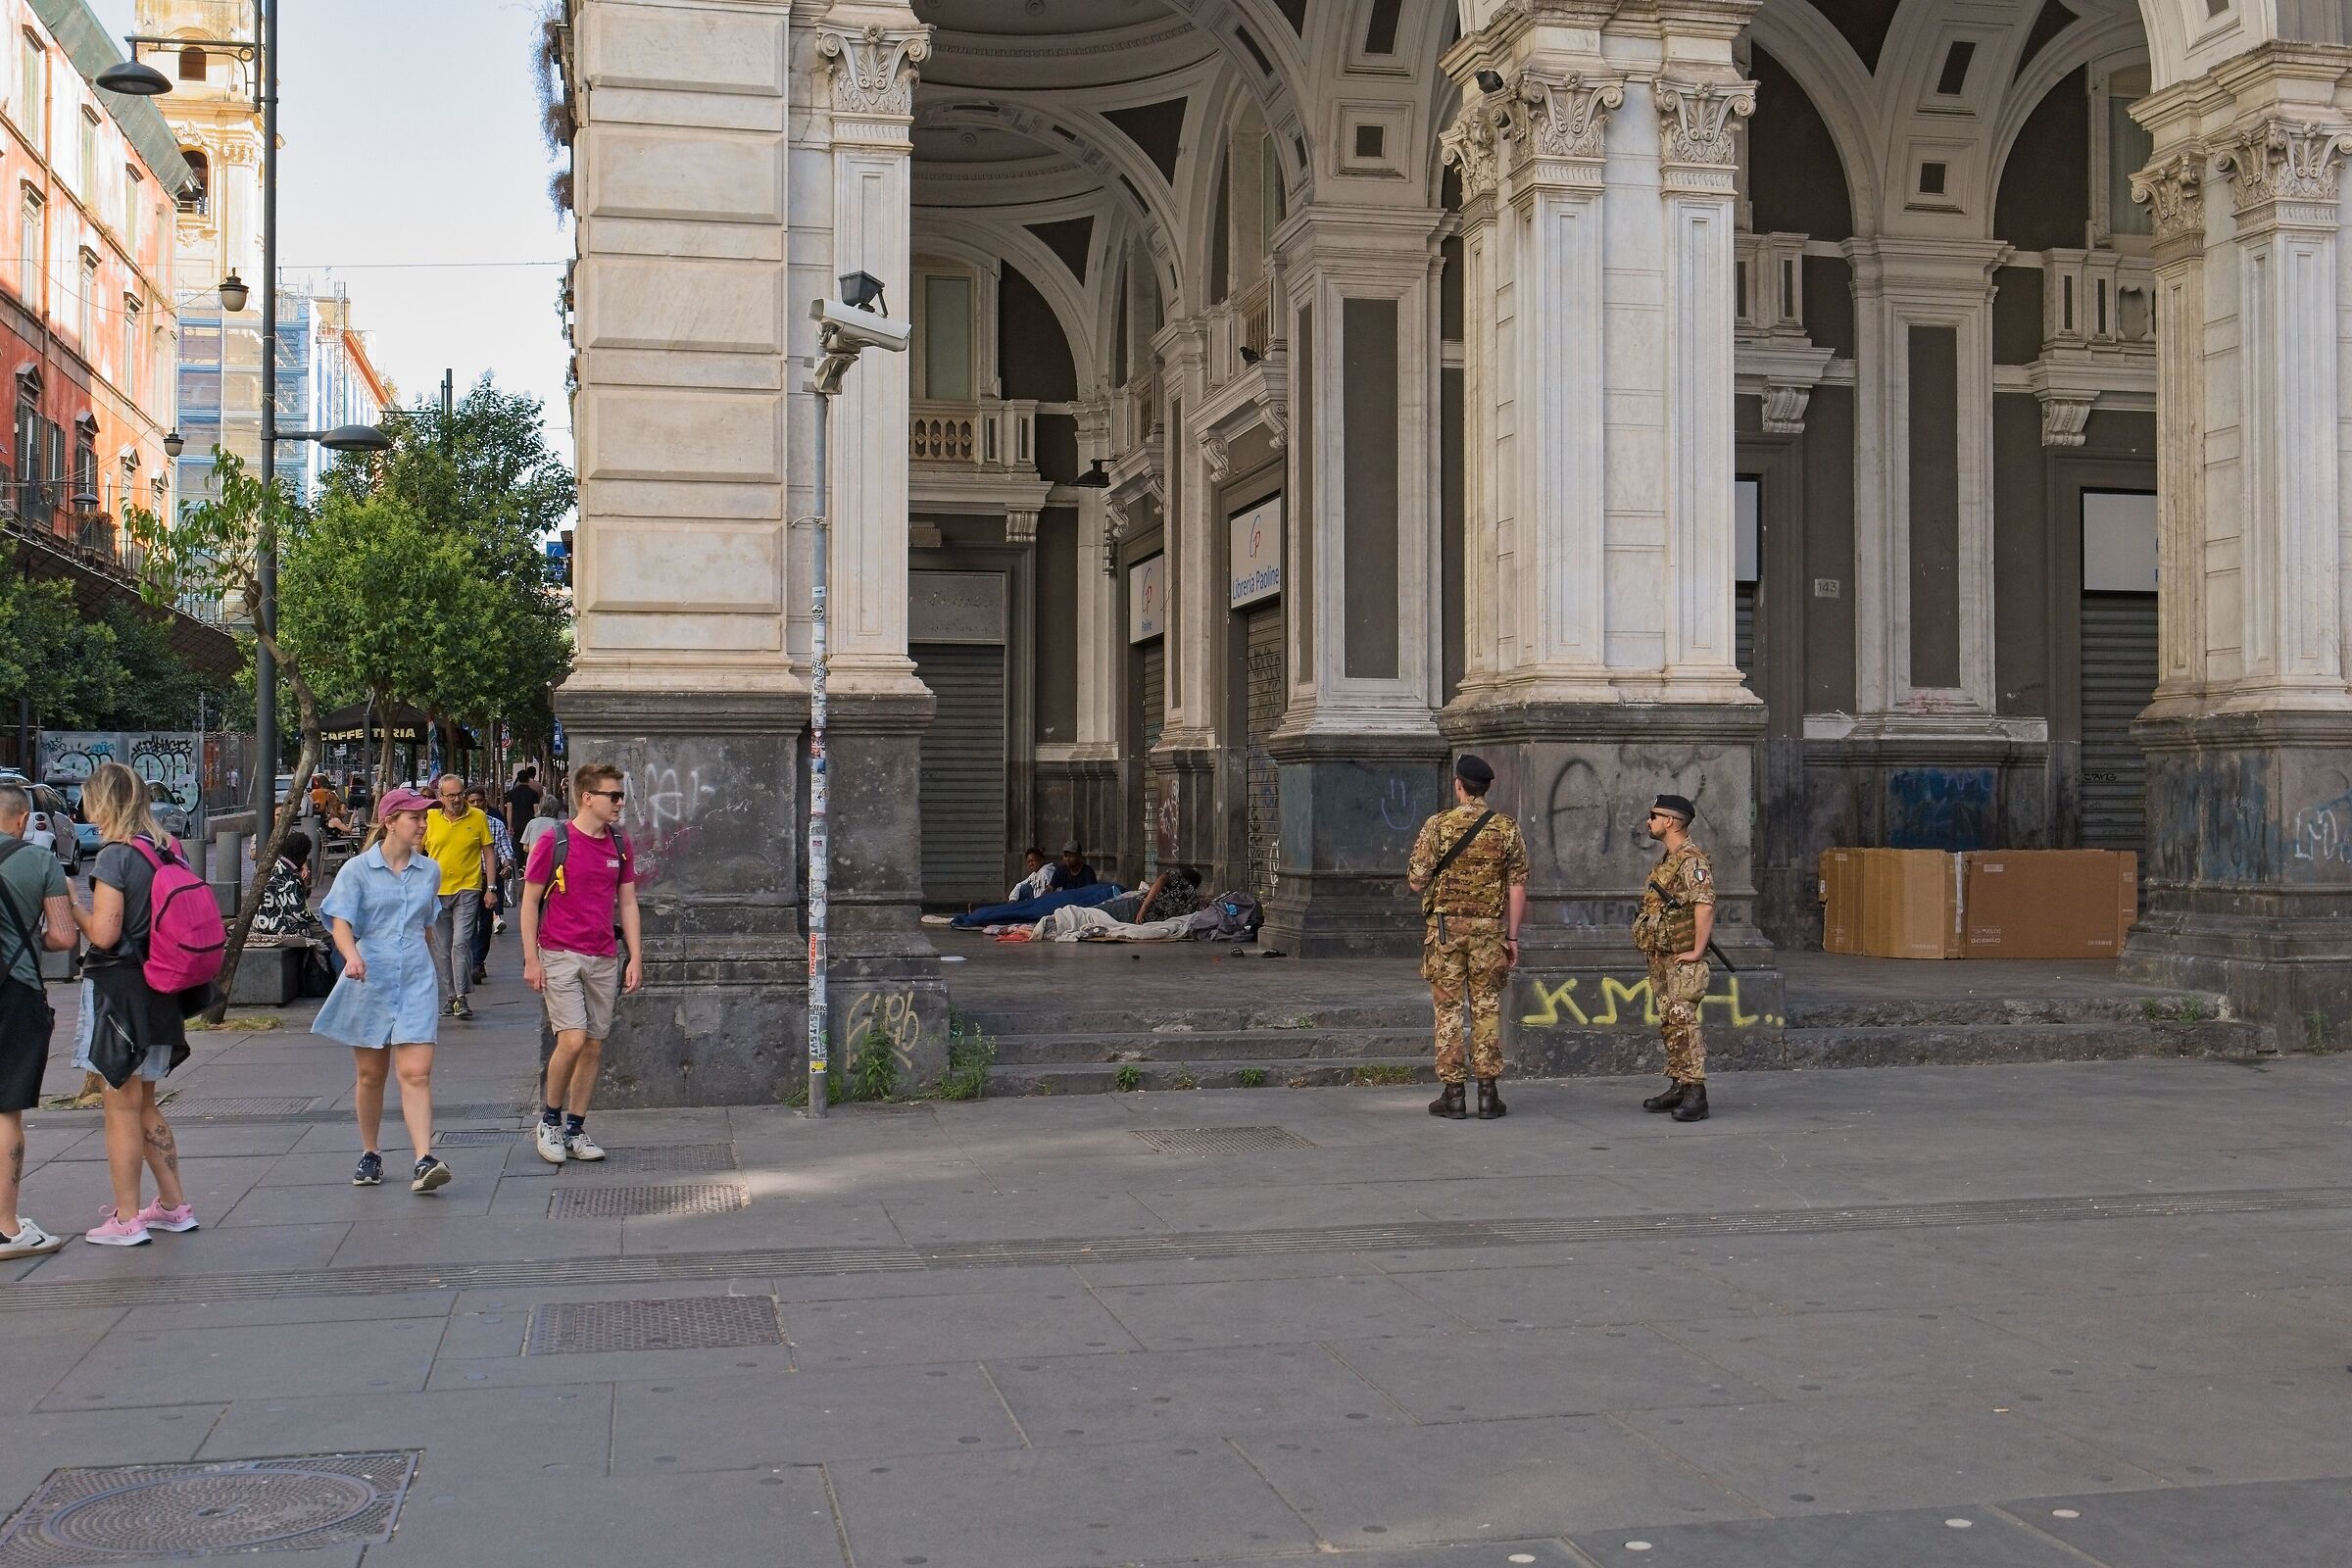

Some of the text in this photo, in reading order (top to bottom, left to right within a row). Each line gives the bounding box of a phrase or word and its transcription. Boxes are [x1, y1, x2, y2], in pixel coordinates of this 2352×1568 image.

[1232, 564, 1280, 600] Libreria Paoline
[1818, 581, 1837, 593] 143
